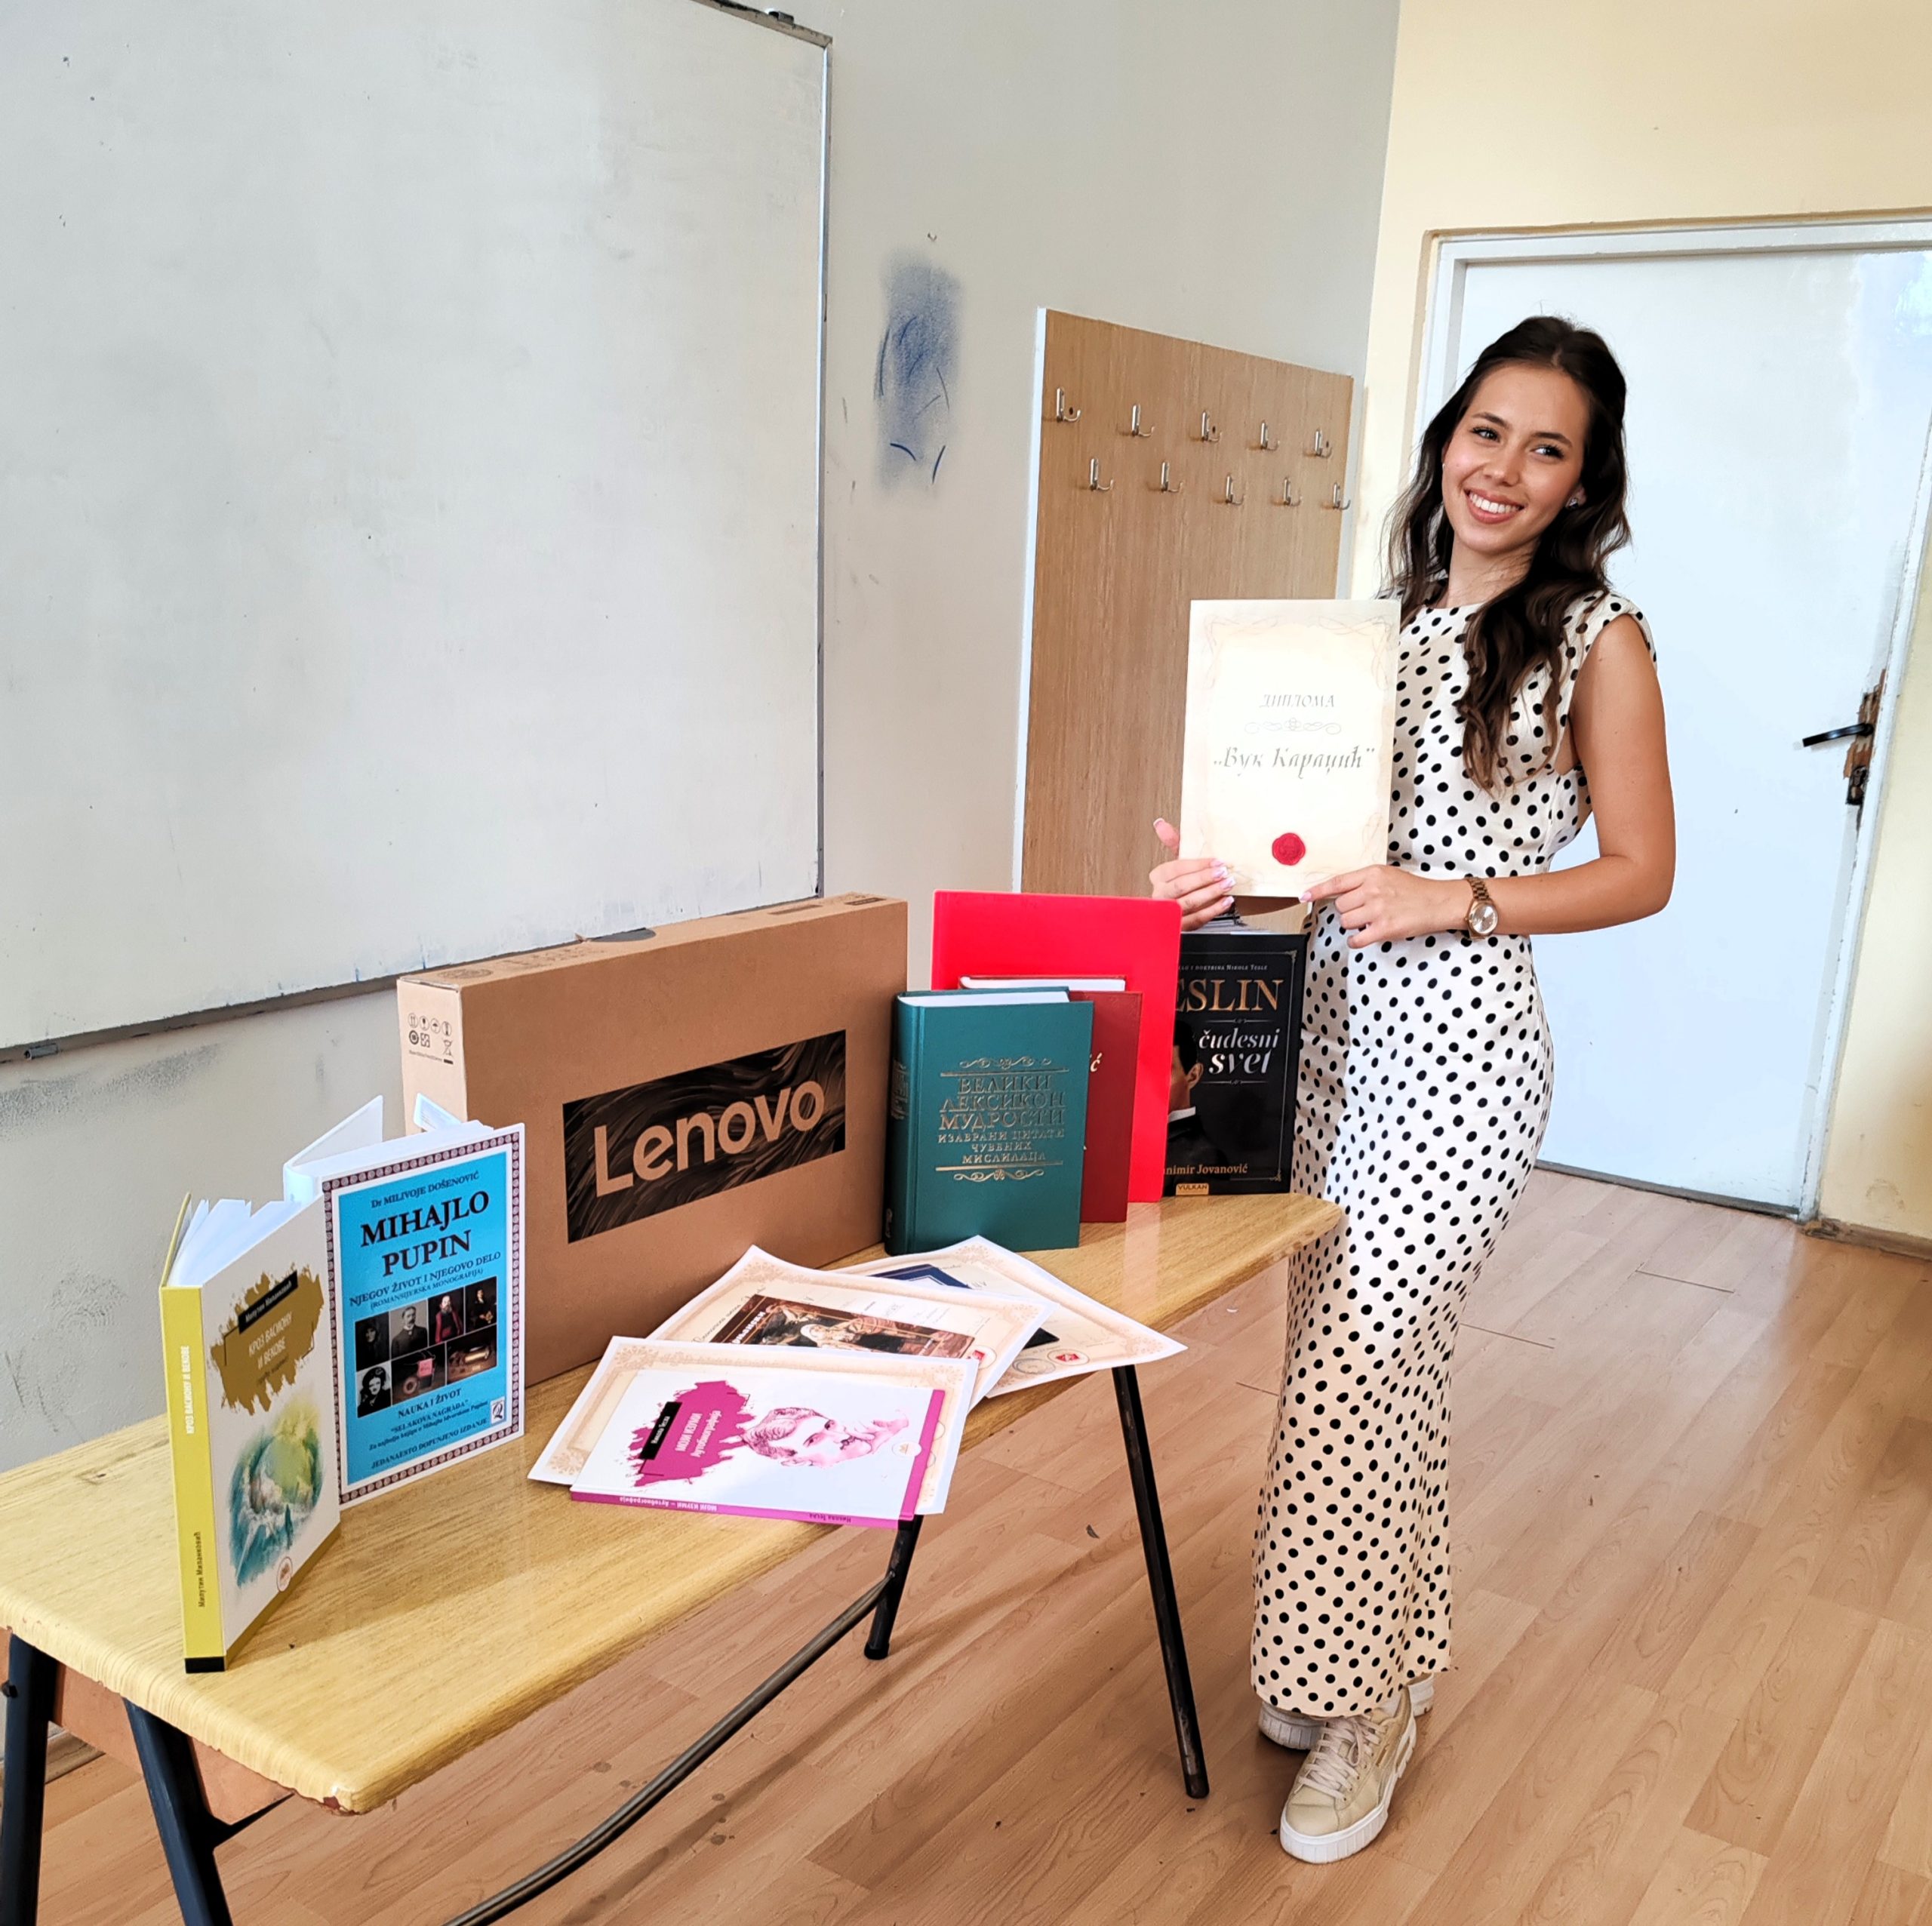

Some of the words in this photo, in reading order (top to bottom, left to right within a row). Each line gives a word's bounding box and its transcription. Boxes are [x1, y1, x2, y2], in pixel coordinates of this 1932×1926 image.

[1259, 694, 1335, 708] ДИПЛОМА
[1199, 1027, 1281, 1049] čudesni
[958, 1075, 1051, 1094] ВЕЛИКИ
[940, 1092, 1066, 1113] ЛЕКСИКОН
[938, 1109, 1066, 1132] МУДРОСТИ
[594, 1081, 825, 1198] Lenovo
[1196, 1163, 1248, 1174] Jovanović
[371, 1199, 383, 1208] Dr
[383, 1187, 426, 1205] MILIVOJE
[428, 1171, 480, 1192] DOŠENOVIĆ
[360, 1190, 490, 1248] MIHAJLO
[382, 1229, 472, 1277] PUPIN
[349, 1288, 389, 1307] NJEGOV
[392, 1275, 423, 1292] ŽIVOT
[423, 1274, 429, 1283] I
[429, 1260, 474, 1281] NJEGOVO
[475, 1251, 501, 1266] DELO
[398, 1401, 429, 1418] NAUKA
[435, 1388, 462, 1405] ŽIVOT
